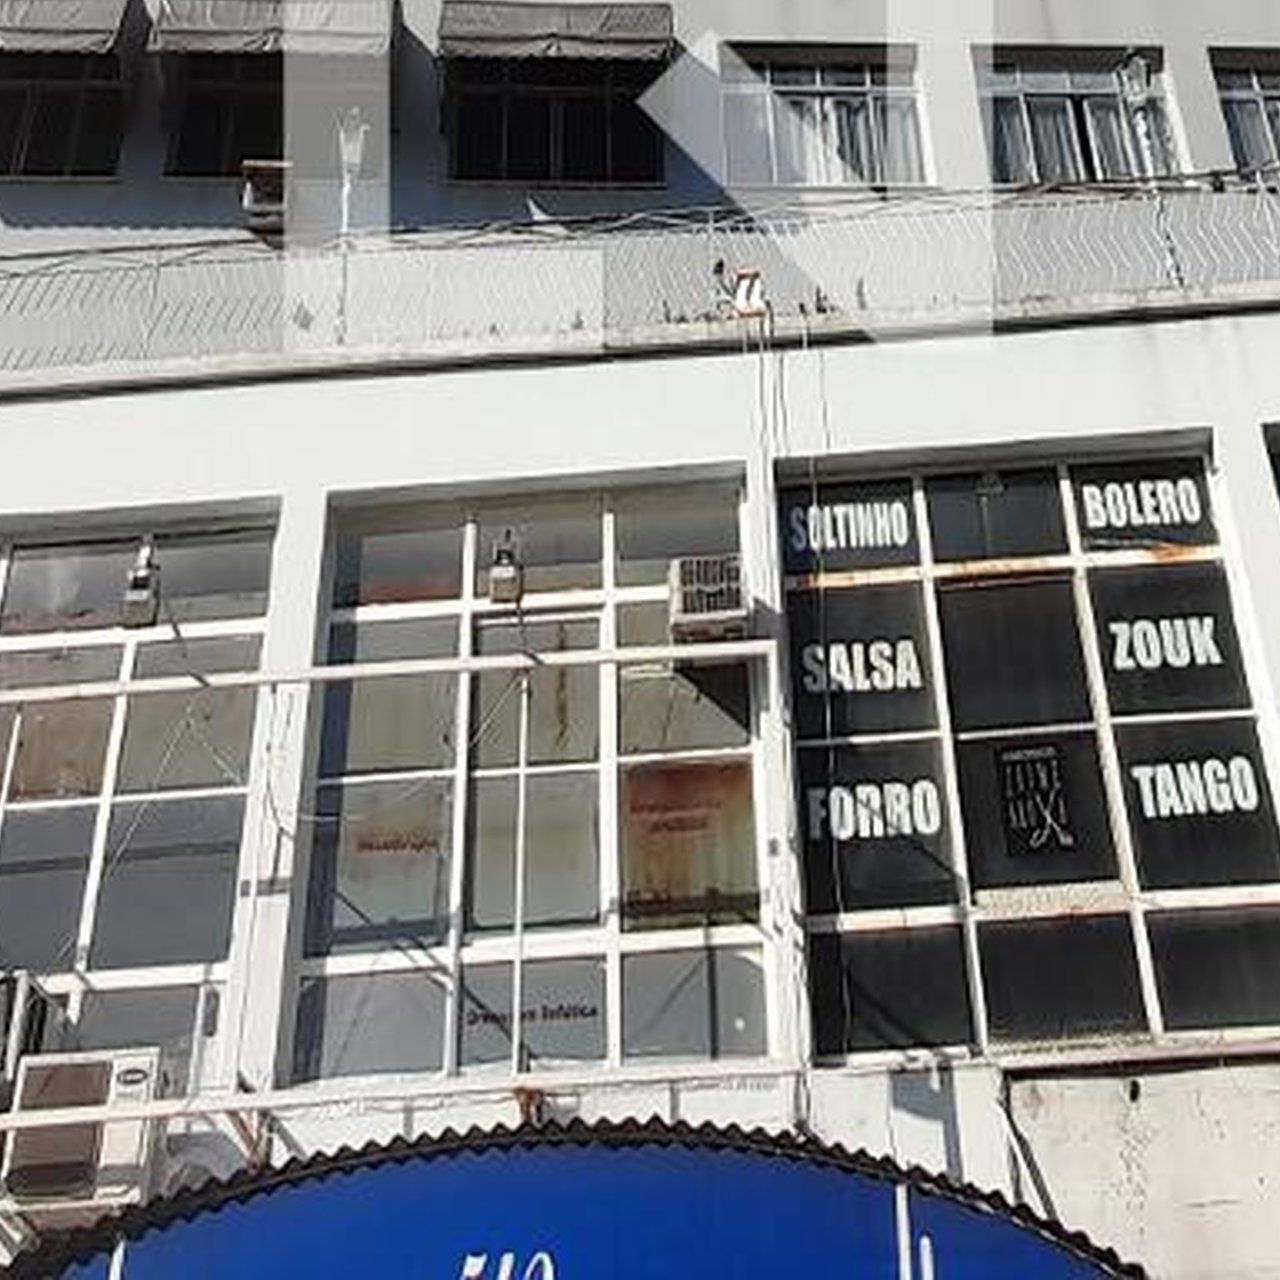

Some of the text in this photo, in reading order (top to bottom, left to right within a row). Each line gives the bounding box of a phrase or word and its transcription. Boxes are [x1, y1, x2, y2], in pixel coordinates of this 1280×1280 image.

[790, 502, 909, 551] SOLTINHO
[1082, 479, 1201, 528] BOLERO
[802, 640, 922, 692] SALSA
[1108, 616, 1223, 671] ZOUK
[807, 780, 941, 841] FORRO
[1130, 756, 1259, 818] TANGO
